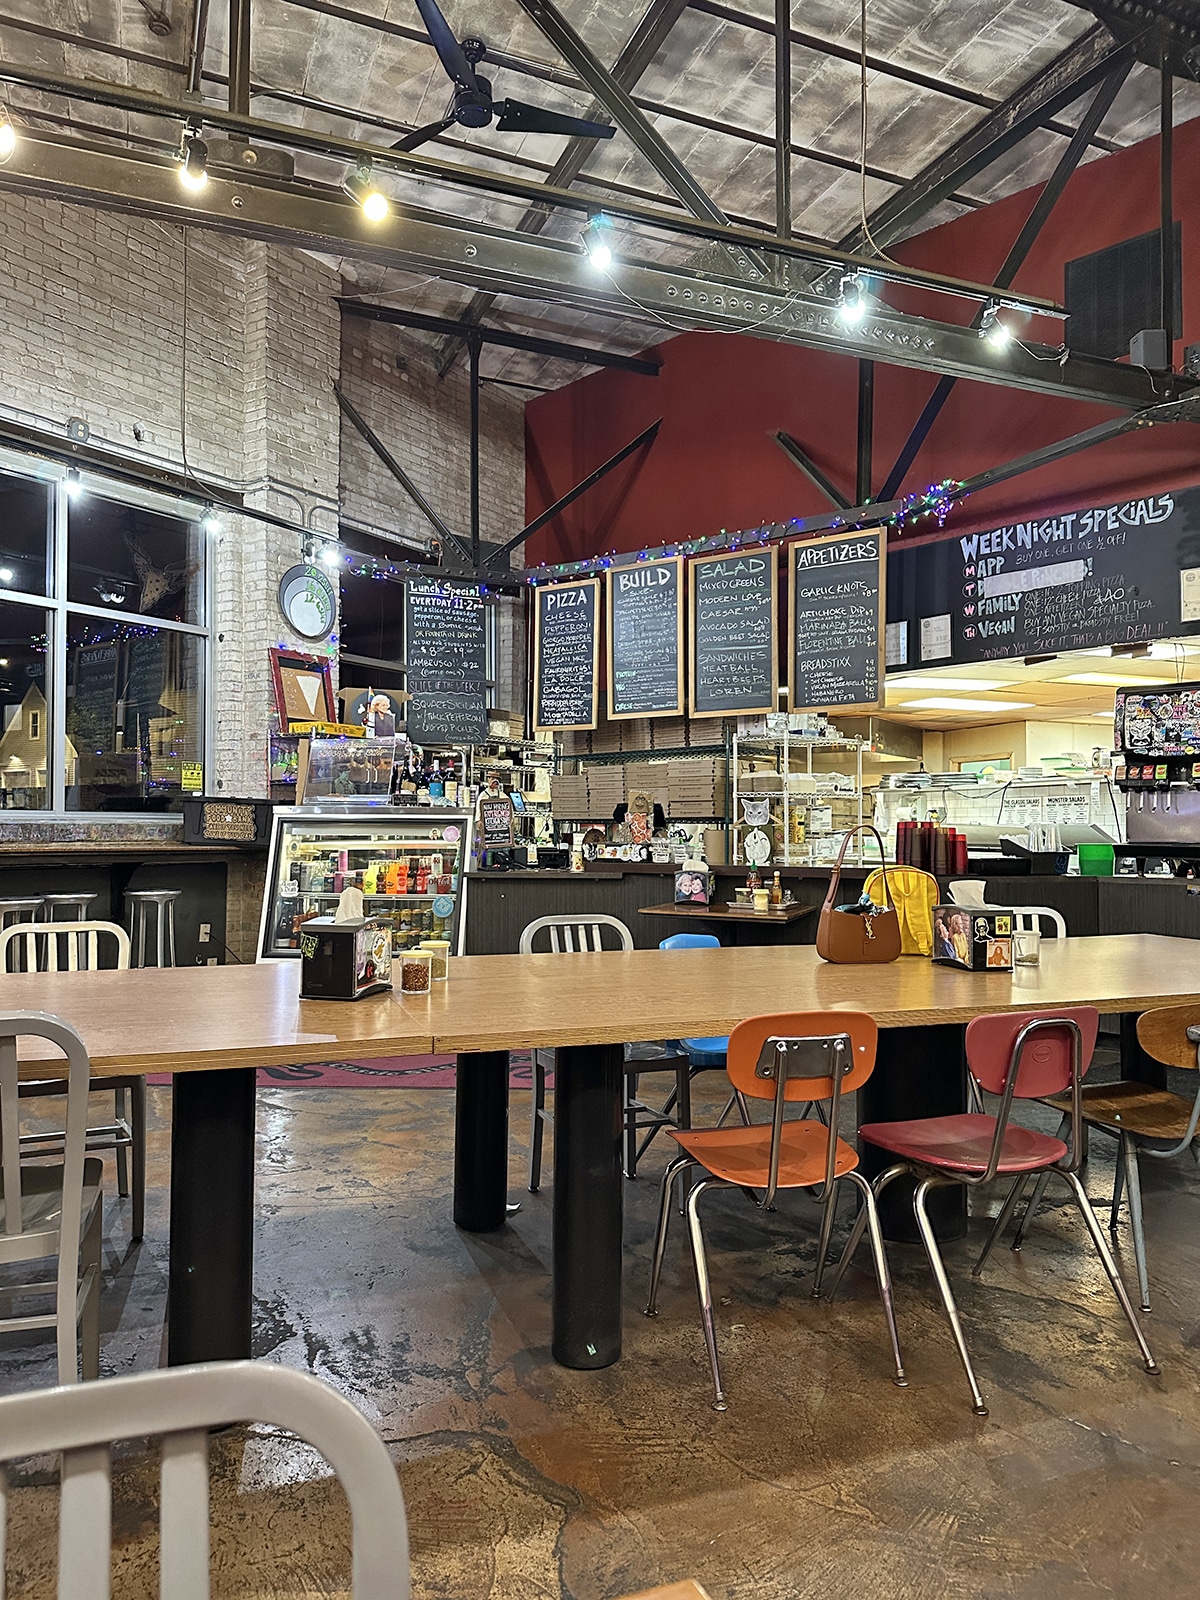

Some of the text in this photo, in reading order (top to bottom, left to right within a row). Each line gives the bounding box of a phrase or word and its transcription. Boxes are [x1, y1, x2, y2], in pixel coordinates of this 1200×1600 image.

[797, 541, 877, 569] APPETIZERS
[965, 532, 1127, 578] M APP BUY GET ONE OFF!
[700, 558, 765, 579] SALAD
[619, 568, 671, 592] BUILD
[699, 576, 765, 592] MIXED GREENS
[409, 580, 480, 599] Lunch Special
[800, 585, 835, 598] GARLIC
[837, 581, 868, 593] KNOTS
[965, 584, 975, 596] T
[410, 596, 452, 607] EVERYDAY
[547, 588, 587, 611] PIZZA
[701, 607, 743, 620] CAESAR
[964, 604, 975, 616] W
[454, 616, 477, 624] cheese
[545, 622, 591, 634] PEPPERONI
[699, 622, 738, 632] AVOCADO
[740, 616, 770, 629] SALAD
[800, 621, 847, 633] MARINARA
[965, 627, 975, 637] TH
[978, 616, 1016, 638] VEGAN
[1023, 616, 1041, 629] BUY
[1059, 608, 1086, 622] VEGAN
[1024, 626, 1040, 637] GET
[1114, 610, 1139, 622] FREE!
[1013, 642, 1029, 656] YOU
[1105, 627, 1124, 641] BIG
[698, 651, 767, 664] SANDWICHES
[801, 656, 851, 672] BREADSTIXX
[409, 681, 433, 692] SLICE
[206, 804, 253, 814] COMMUNITY
[207, 813, 252, 824] FOOD BANK
